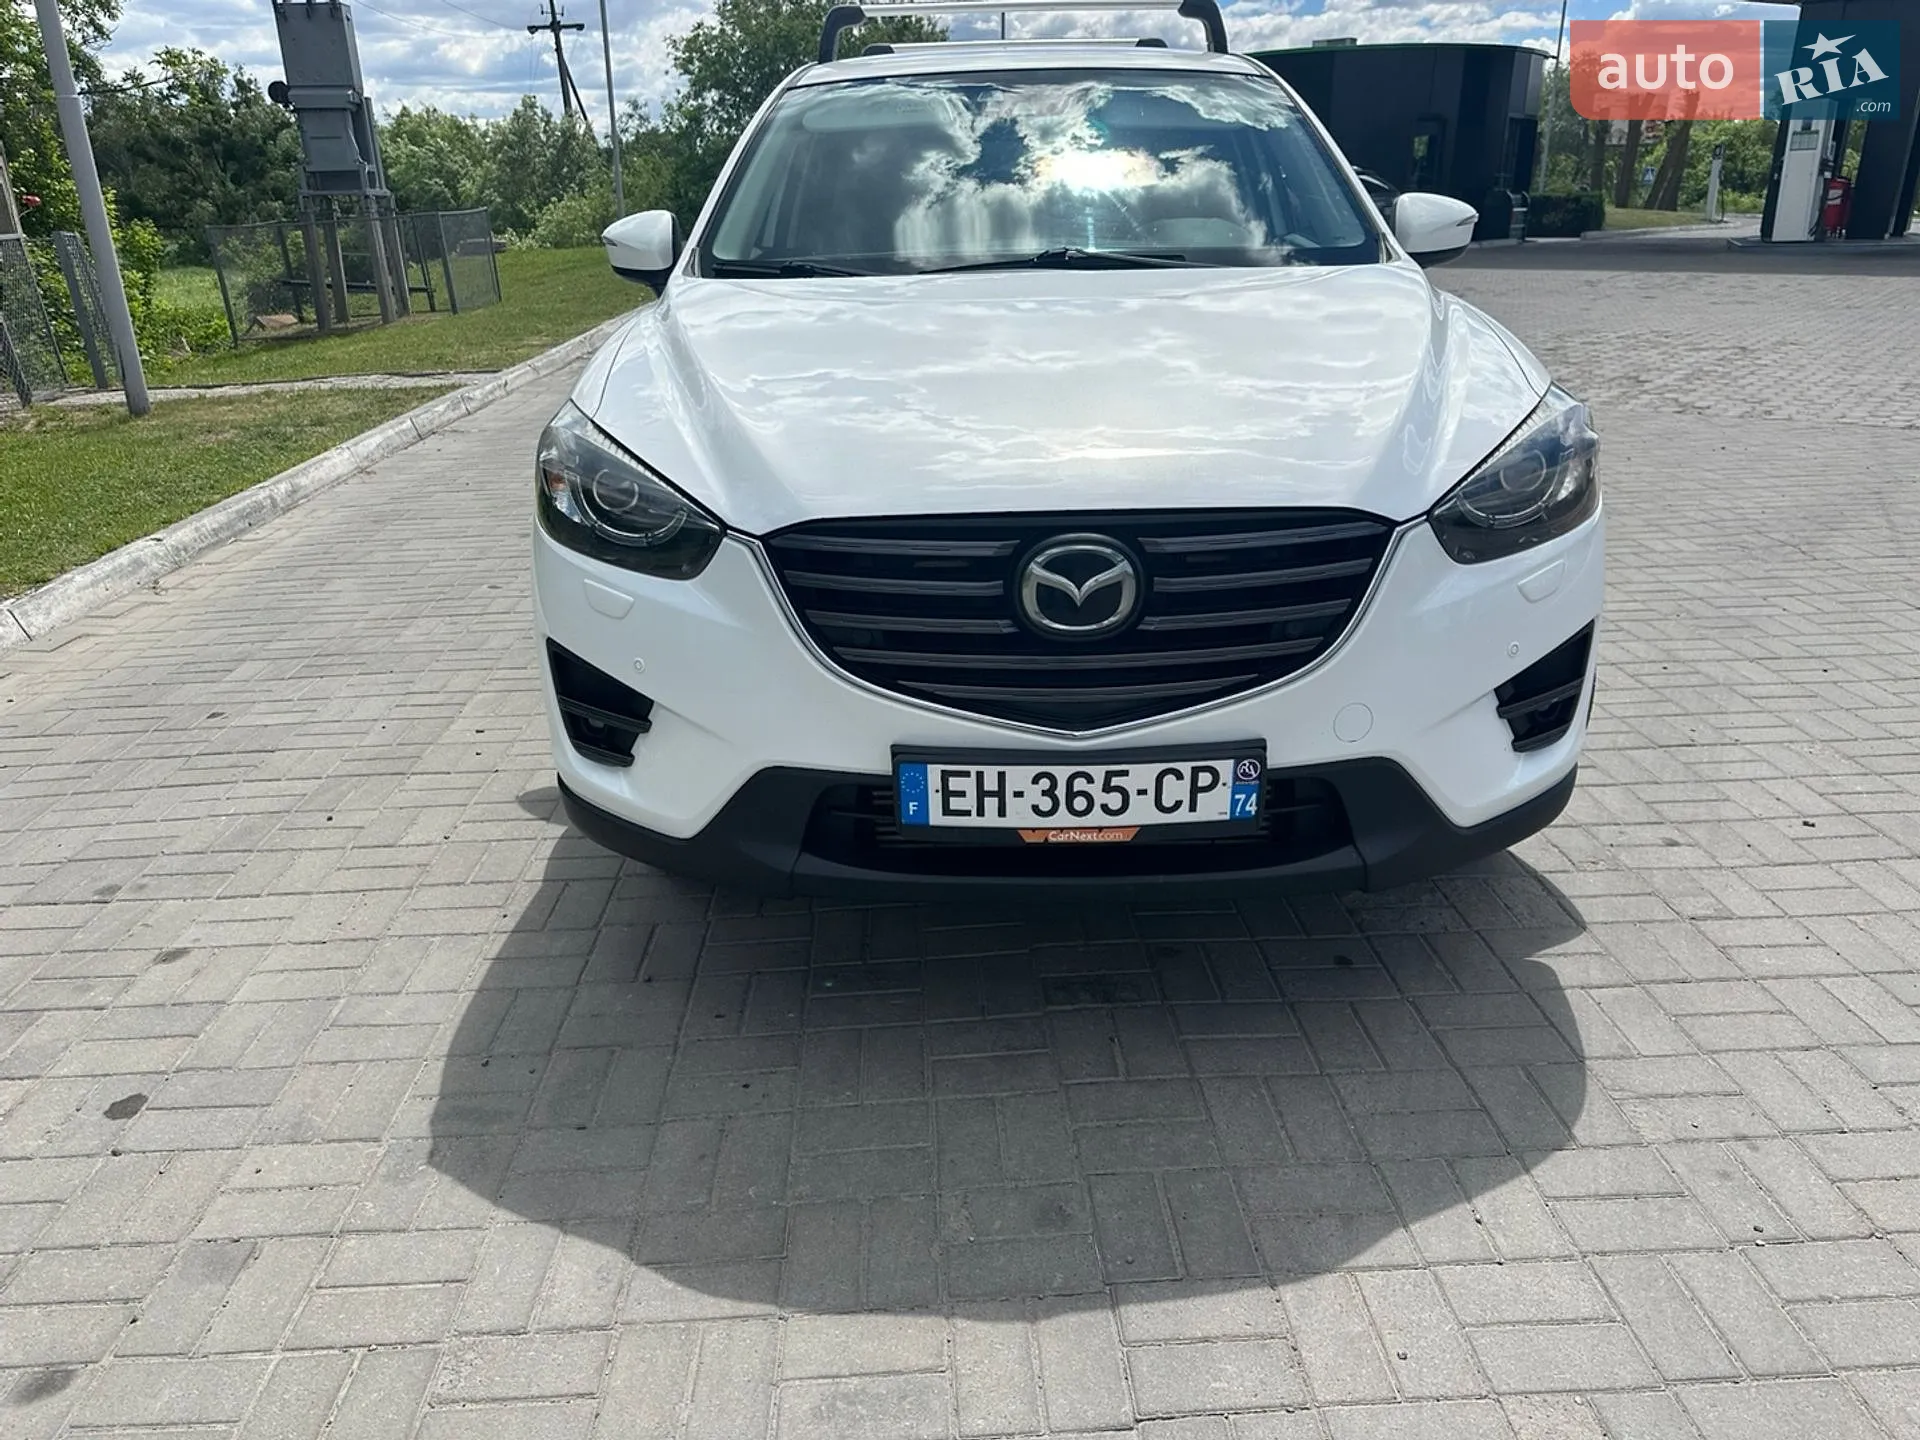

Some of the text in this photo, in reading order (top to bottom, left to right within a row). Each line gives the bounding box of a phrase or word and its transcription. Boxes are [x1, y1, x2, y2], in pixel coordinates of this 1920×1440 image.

[940, 765, 1221, 818] EH-365-CP
[909, 802, 918, 815] F
[1234, 793, 1258, 816] 74
[1048, 830, 1123, 841] CarNext.com
